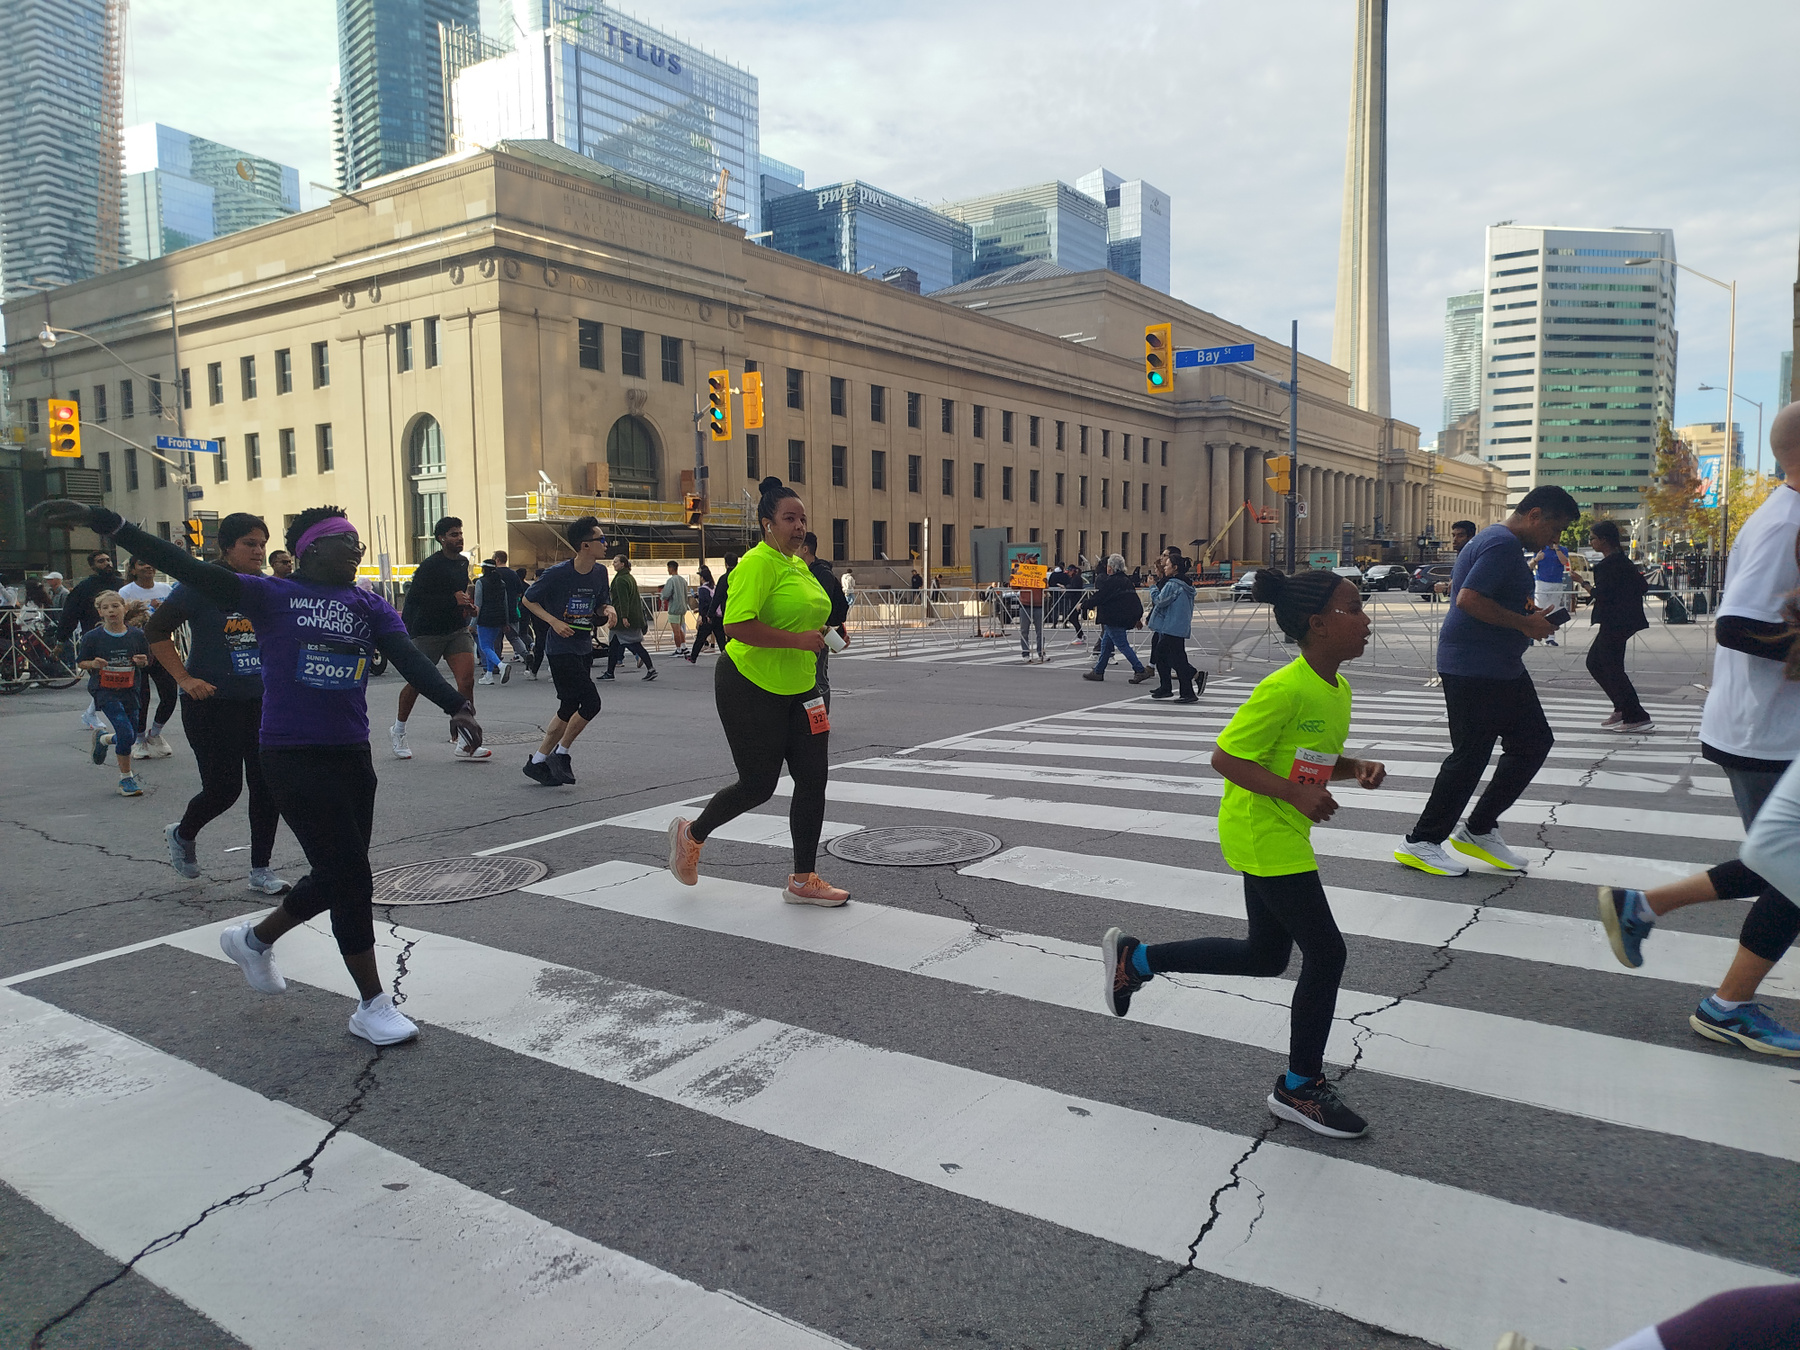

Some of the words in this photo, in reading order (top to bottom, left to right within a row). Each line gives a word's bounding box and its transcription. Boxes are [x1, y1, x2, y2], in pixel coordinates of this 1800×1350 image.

[602, 22, 681, 75] TELUS
[816, 186, 855, 210] pwc
[858, 186, 886, 208] pwc
[562, 193, 590, 209] HILL
[597, 203, 655, 228] FRANKLIN
[662, 224, 693, 239] SIKES
[583, 211, 621, 230] ALLAN
[630, 225, 676, 244] CUNARD
[563, 218, 625, 241] FAWCETT
[639, 240, 693, 261] STEPHAN
[569, 275, 619, 299] POSTAL
[625, 290, 676, 311] STATION
[683, 303, 691, 315] A
[1197, 350, 1220, 364] Bay
[1224, 347, 1231, 355] St
[168, 437, 192, 449] Front
[199, 440, 208, 450] W
[289, 597, 327, 610] WALK
[296, 615, 353, 634] ONTARIO
[312, 608, 354, 624] LUPUS
[305, 654, 330, 663] SUNITA
[304, 662, 354, 679] 29067
[1299, 765, 1319, 775] ZADIE
